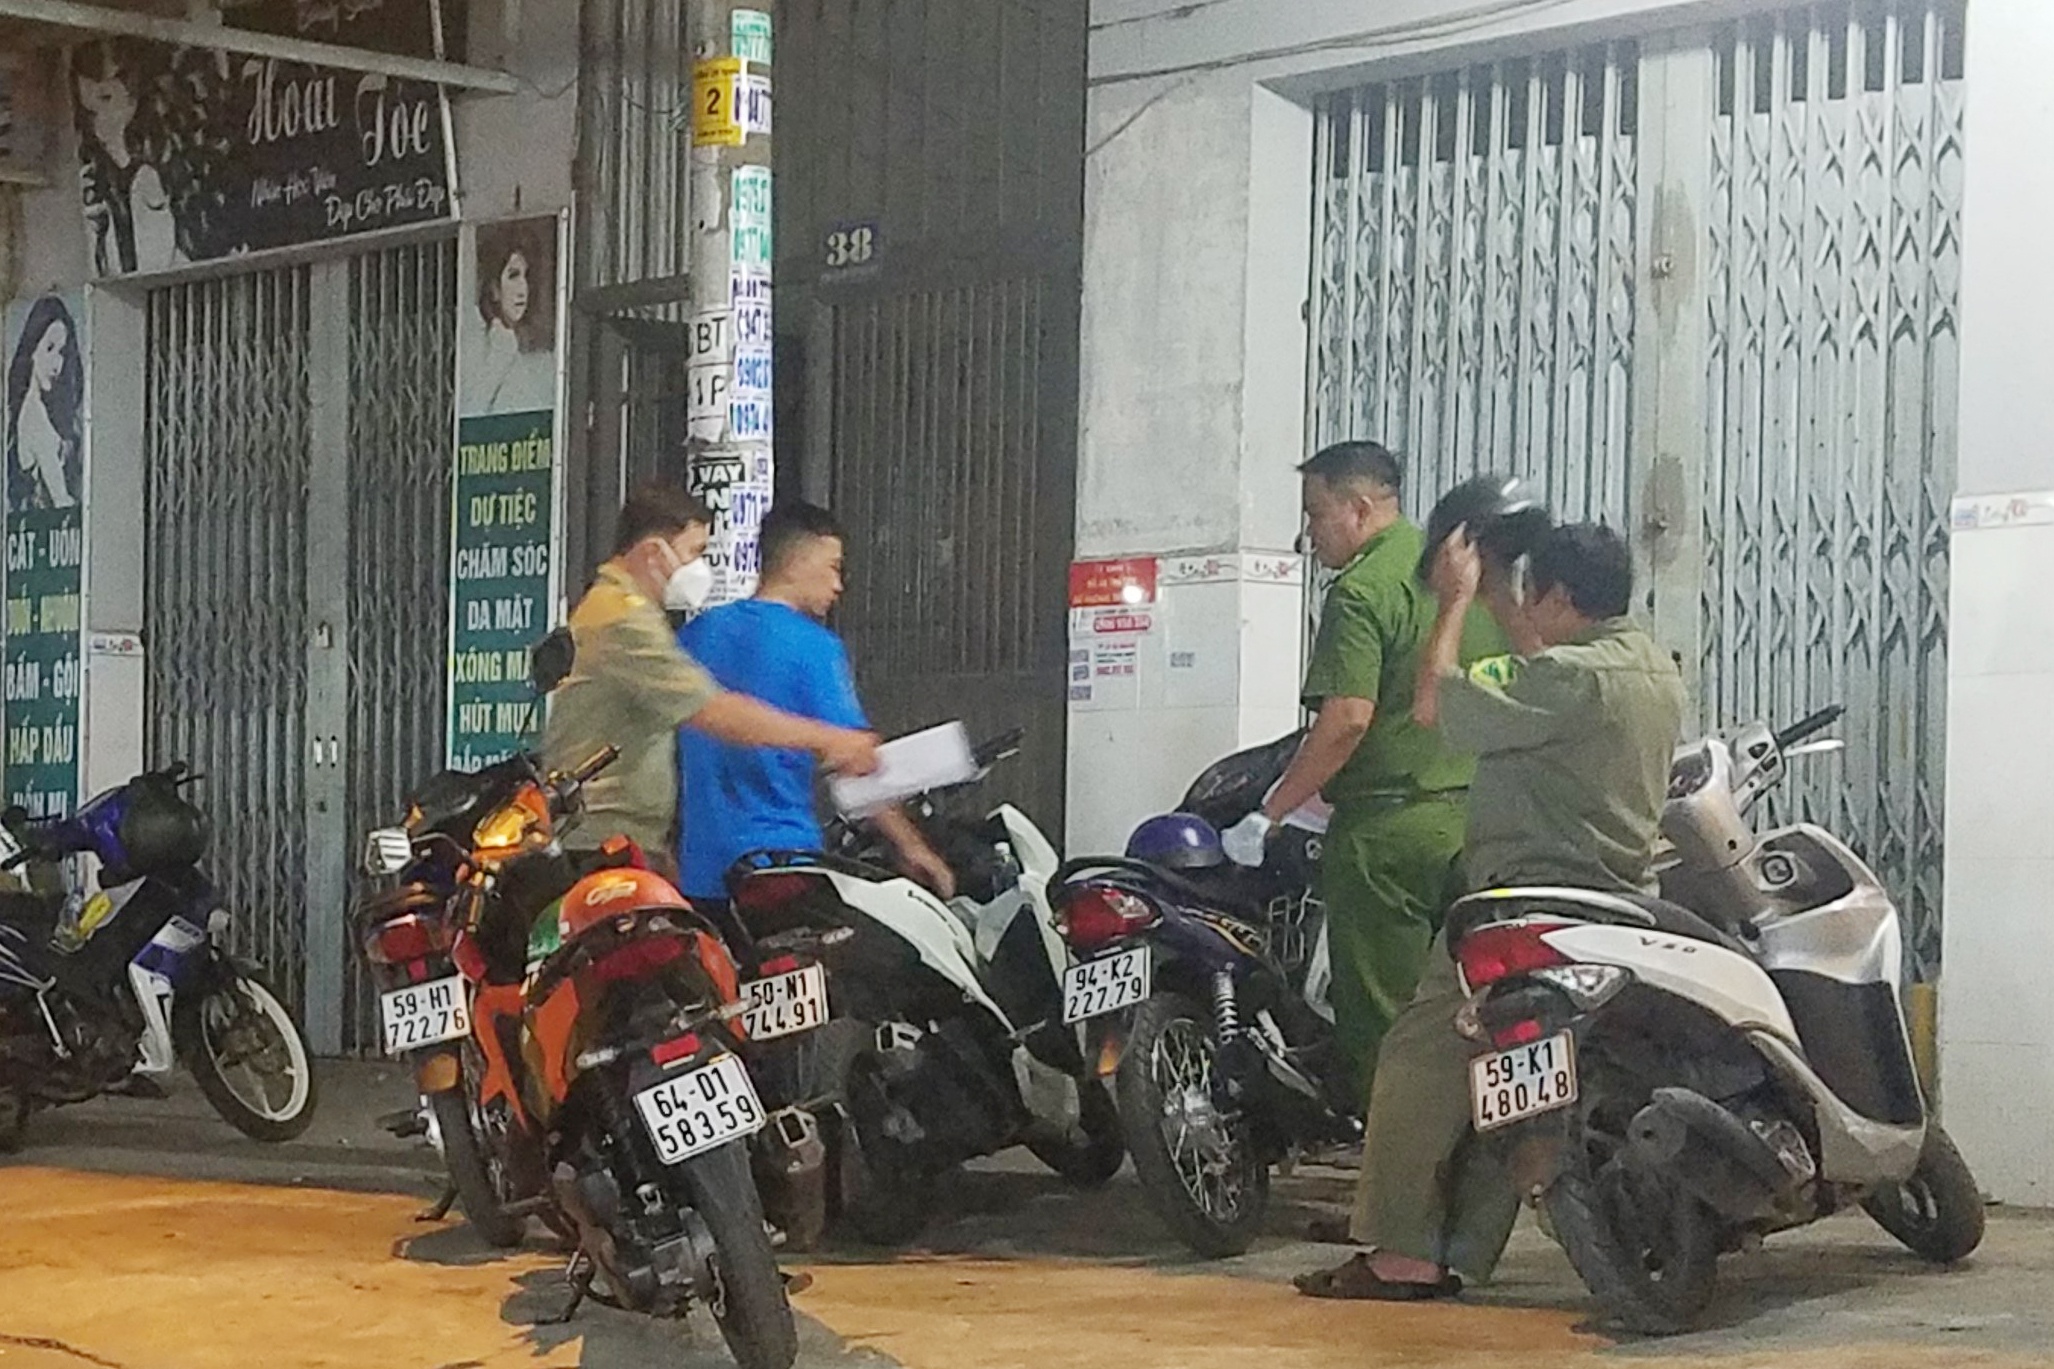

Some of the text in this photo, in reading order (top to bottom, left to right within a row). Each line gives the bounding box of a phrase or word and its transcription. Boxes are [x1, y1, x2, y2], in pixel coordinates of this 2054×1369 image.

[706, 87, 721, 116] 2
[826, 227, 872, 266] 38
[697, 317, 727, 354] BT
[460, 442, 508, 476] TRANG
[698, 463, 742, 483] VAY
[498, 486, 537, 530] TIỆC
[457, 539, 548, 579] CHĂM SÓC
[468, 593, 533, 635] DA MẶT
[6, 651, 40, 700] BẤM
[53, 652, 78, 706] GỘI
[459, 697, 492, 733] HÚT
[10, 714, 39, 765] HẤP
[1076, 955, 1133, 991] 94-K2
[393, 984, 451, 1017] 59-H1
[1068, 976, 1142, 1019] 227.79
[388, 1007, 465, 1047] 722.76
[746, 998, 818, 1038] 744.91
[1486, 1042, 1553, 1087] 59-K1
[654, 1066, 731, 1117] 64-D1
[1481, 1070, 1568, 1122] 480.48
[657, 1095, 756, 1155] 583.59
